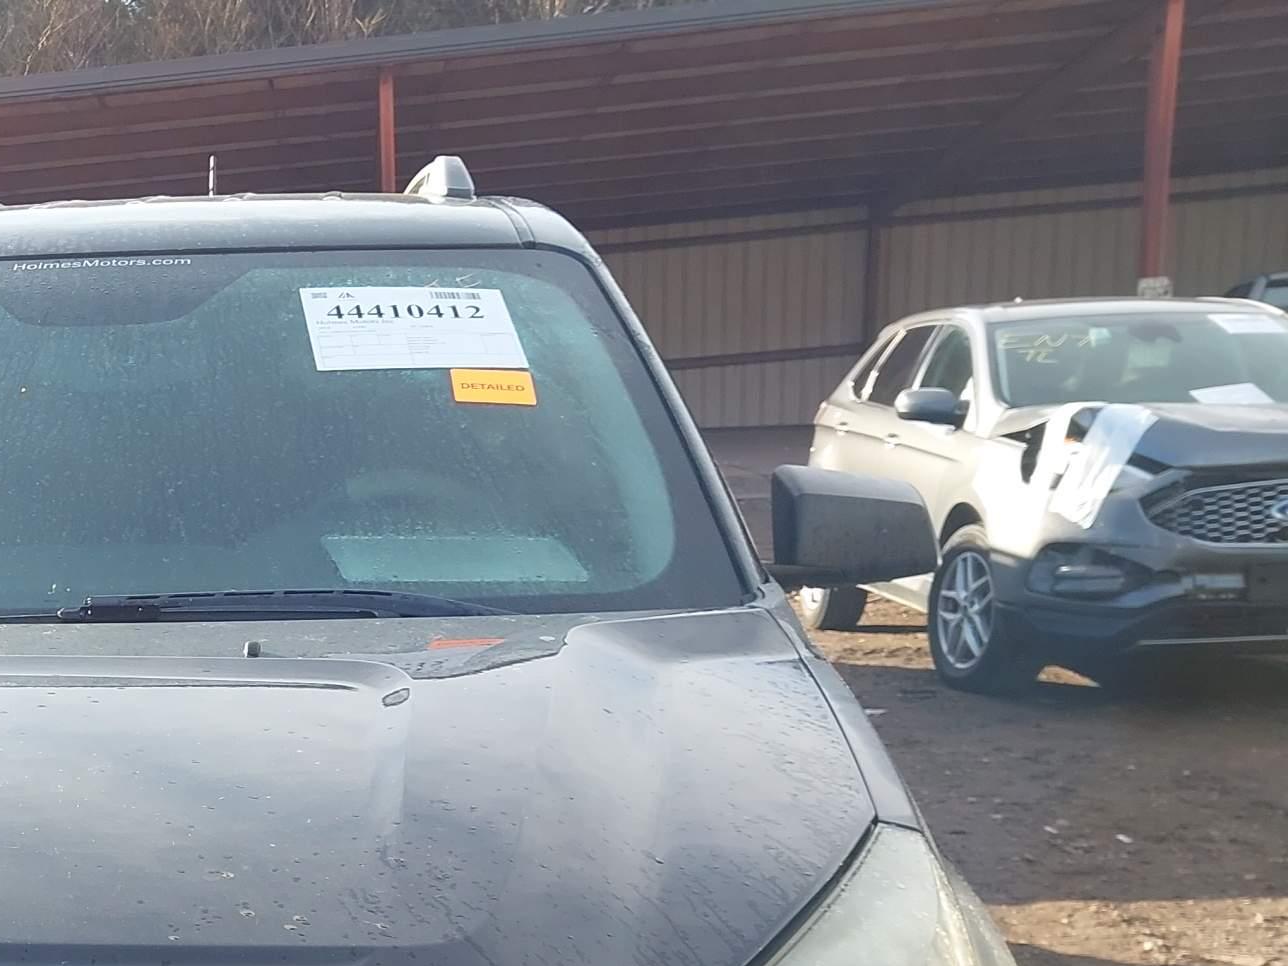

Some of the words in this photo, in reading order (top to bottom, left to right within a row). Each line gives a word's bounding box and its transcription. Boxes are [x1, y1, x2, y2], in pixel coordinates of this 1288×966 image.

[12, 257, 192, 271] HolmesMotors.com
[326, 303, 485, 320] 44410412
[460, 382, 525, 392] DETAILED
